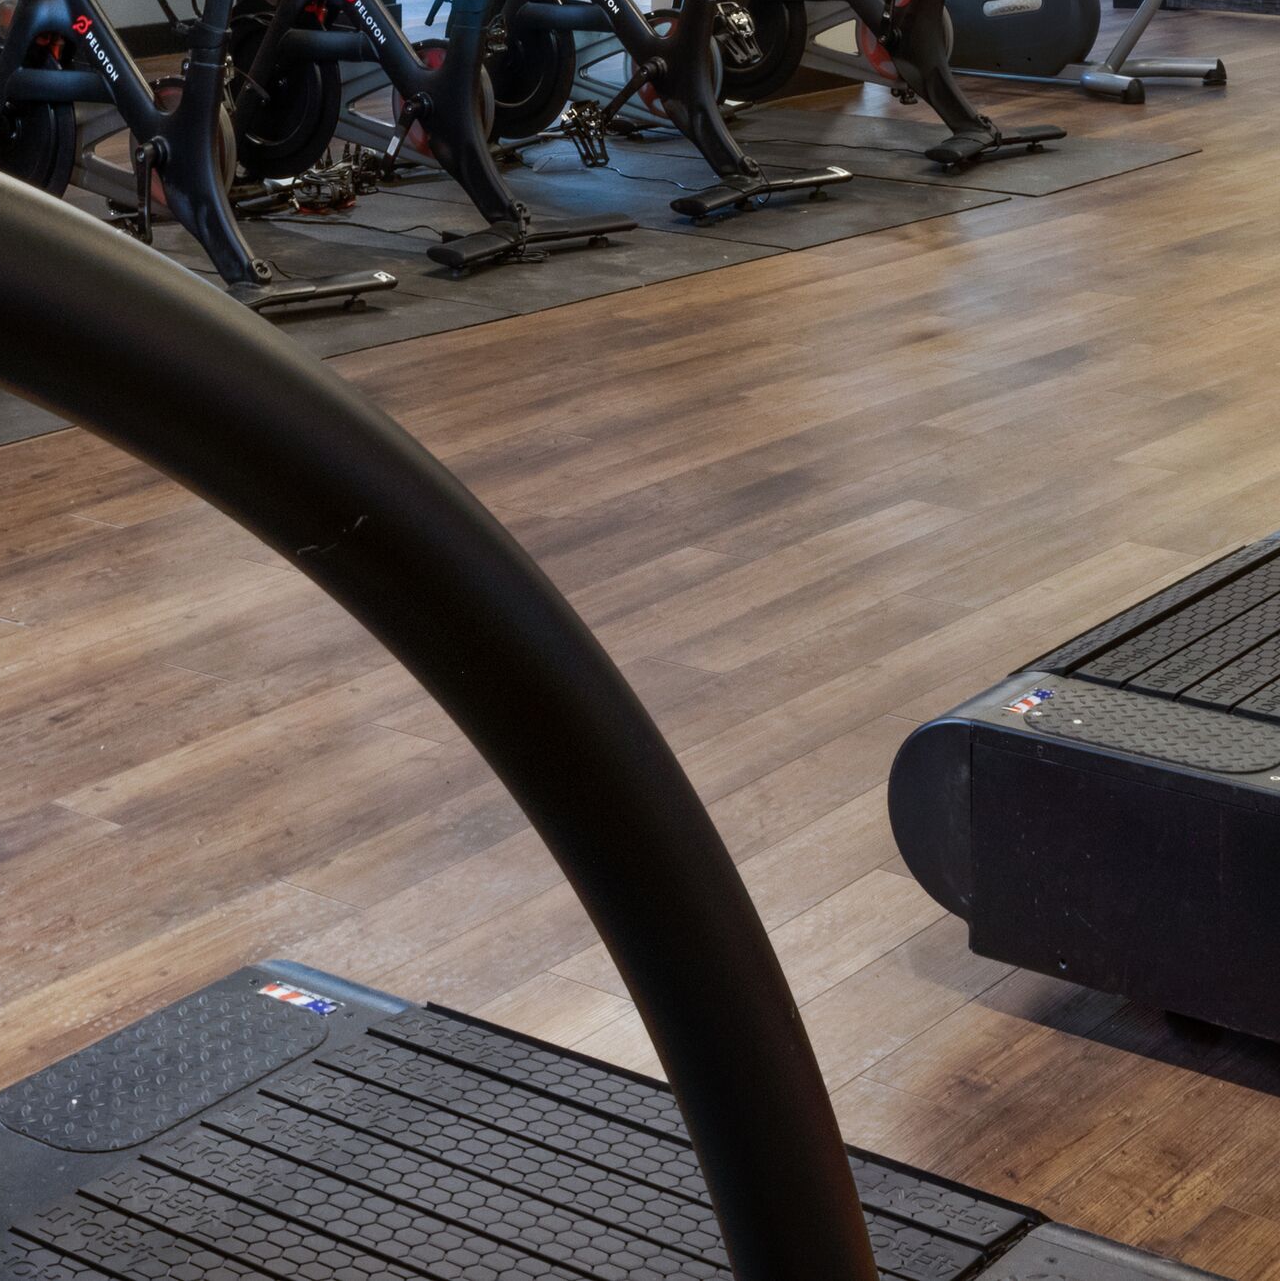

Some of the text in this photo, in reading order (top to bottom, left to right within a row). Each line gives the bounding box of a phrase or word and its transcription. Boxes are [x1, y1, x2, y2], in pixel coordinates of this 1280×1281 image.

[354, 0, 387, 44] PELOTON
[85, 31, 119, 82] PELOTON
[870, 1233, 960, 1278] 4FRO
